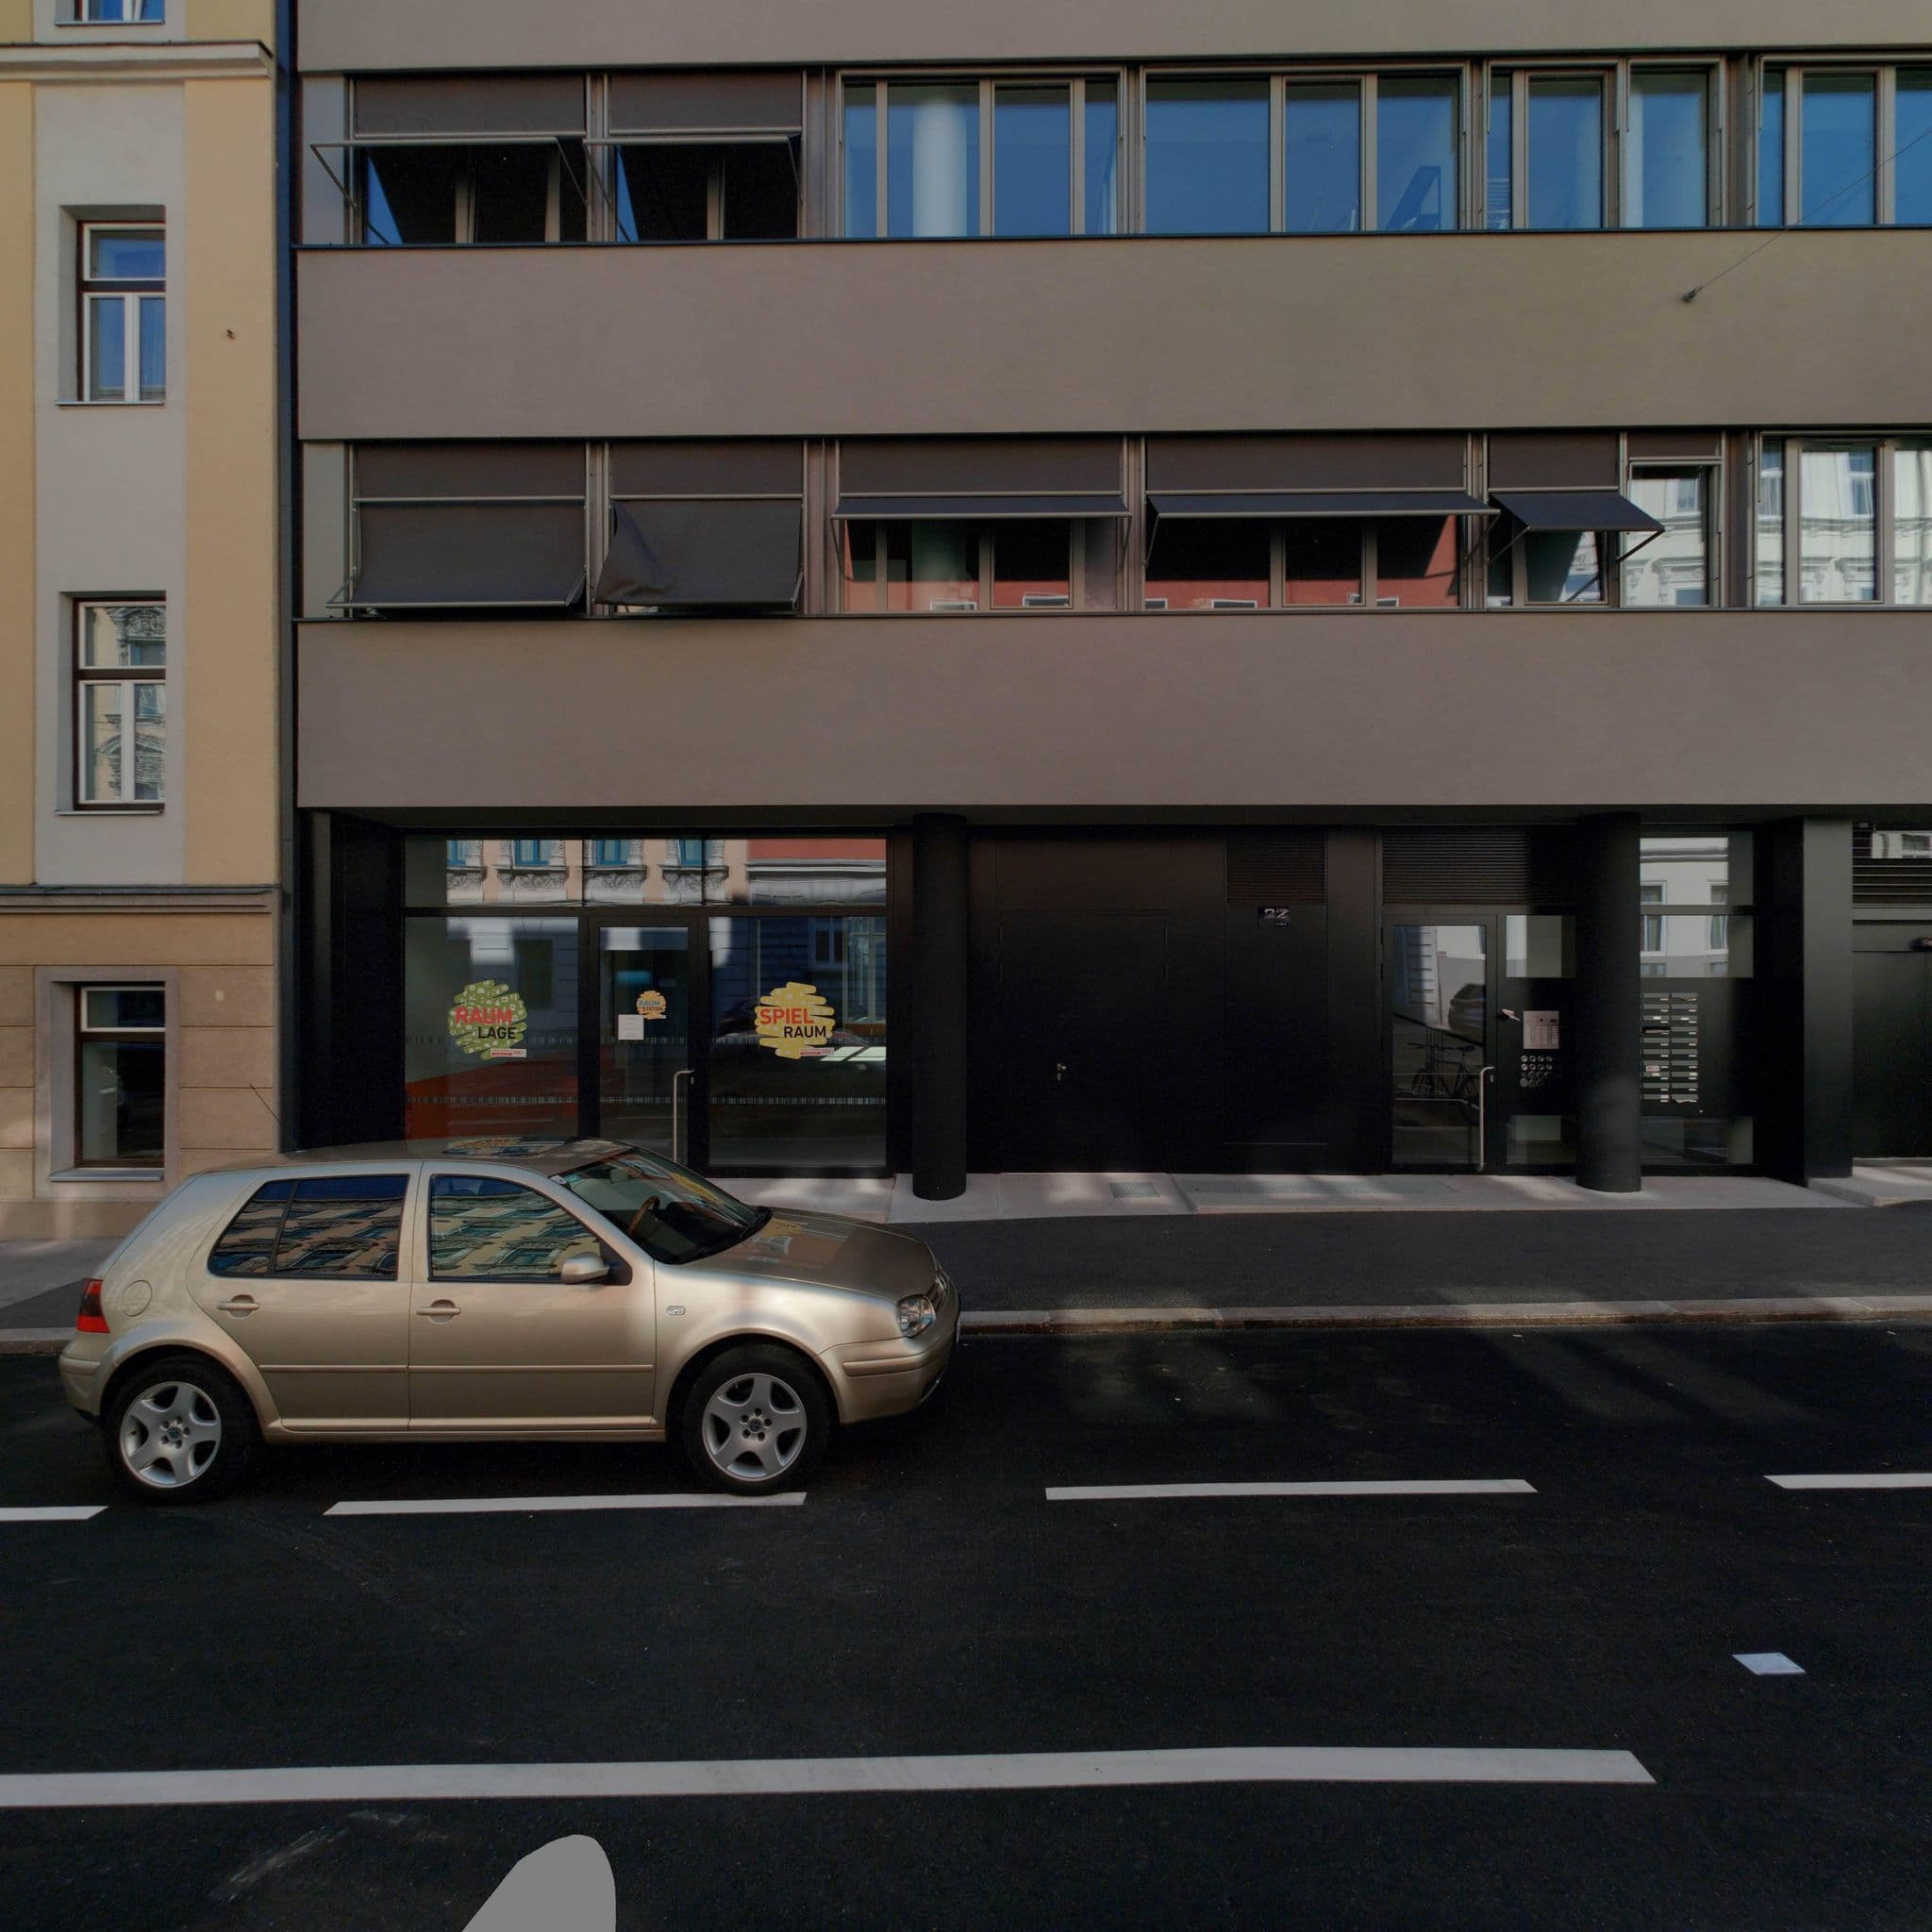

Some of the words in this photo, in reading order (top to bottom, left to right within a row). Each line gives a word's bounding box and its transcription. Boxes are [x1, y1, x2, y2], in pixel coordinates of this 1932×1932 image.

[454, 1005, 513, 1025] RAUM
[759, 1008, 814, 1024] SPIEL
[477, 1025, 516, 1039] LAGE
[784, 1025, 826, 1038] RAUM
